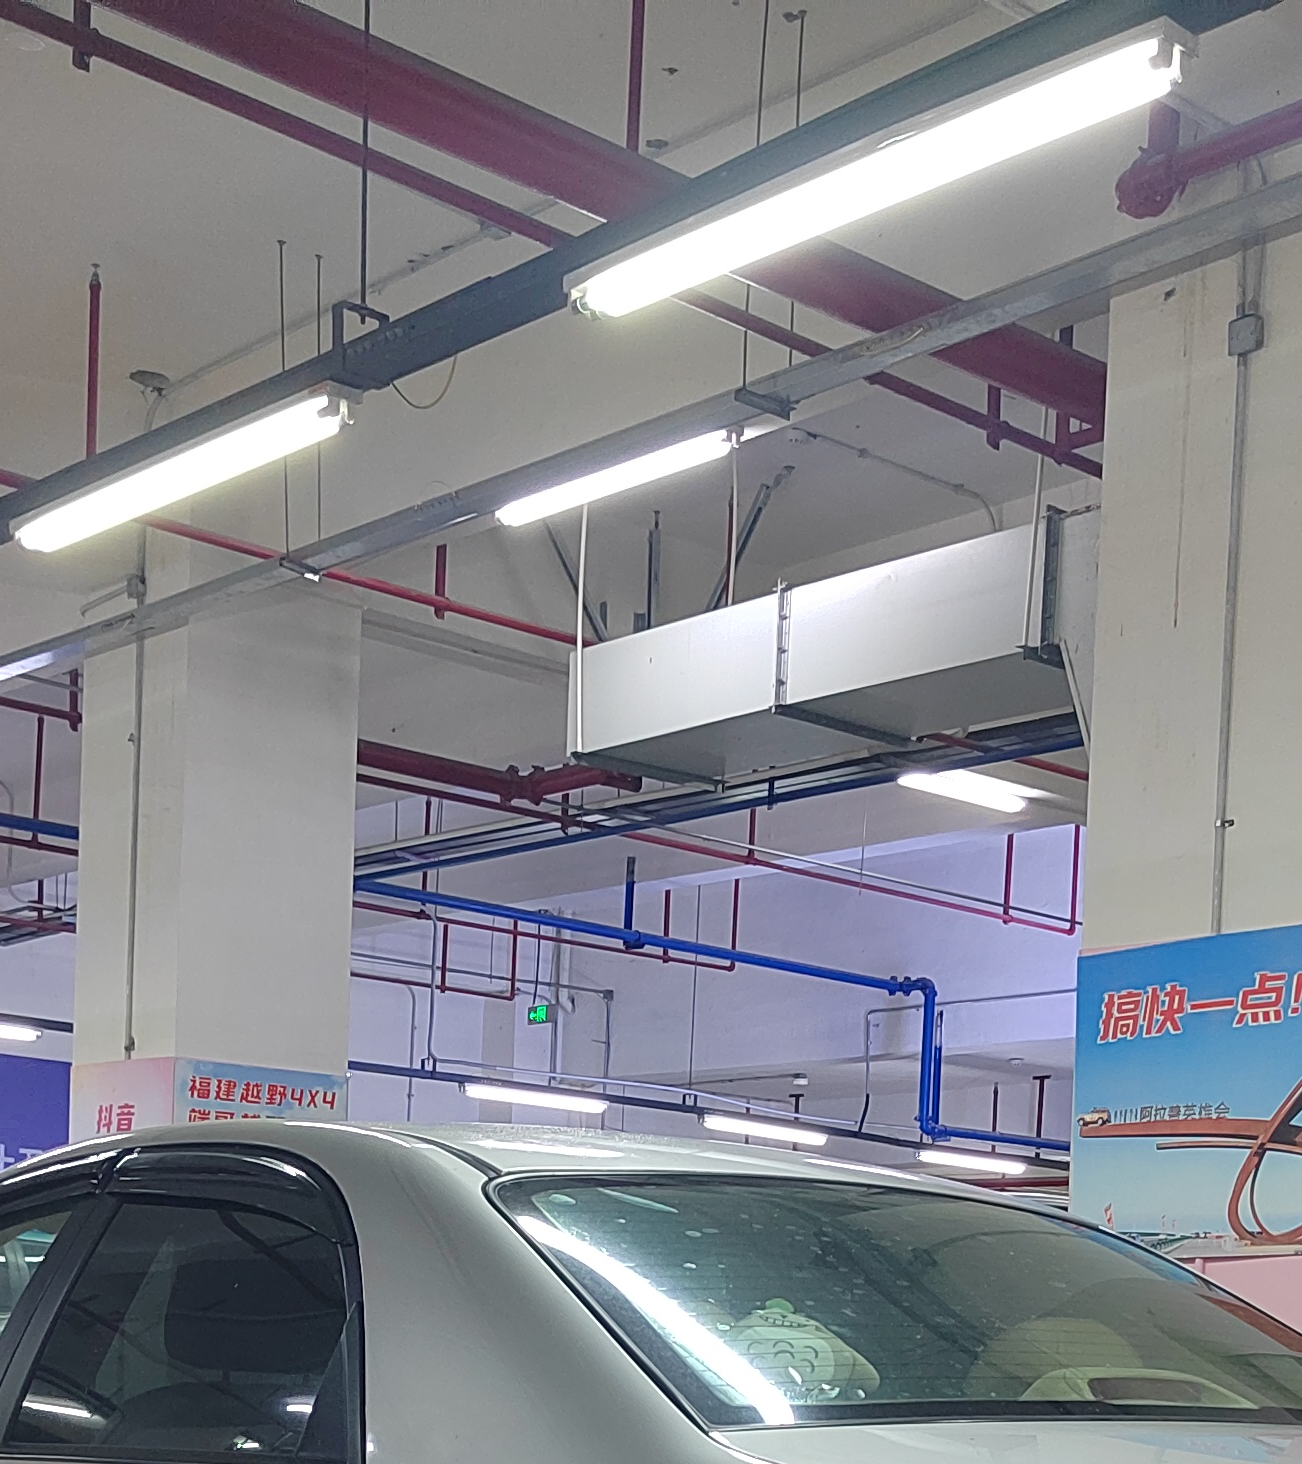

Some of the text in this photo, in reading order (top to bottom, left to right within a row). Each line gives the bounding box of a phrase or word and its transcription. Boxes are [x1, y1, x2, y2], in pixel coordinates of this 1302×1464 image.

[188, 1076, 337, 1110] 福建越野4X4
[96, 1103, 136, 1134] 抖音
